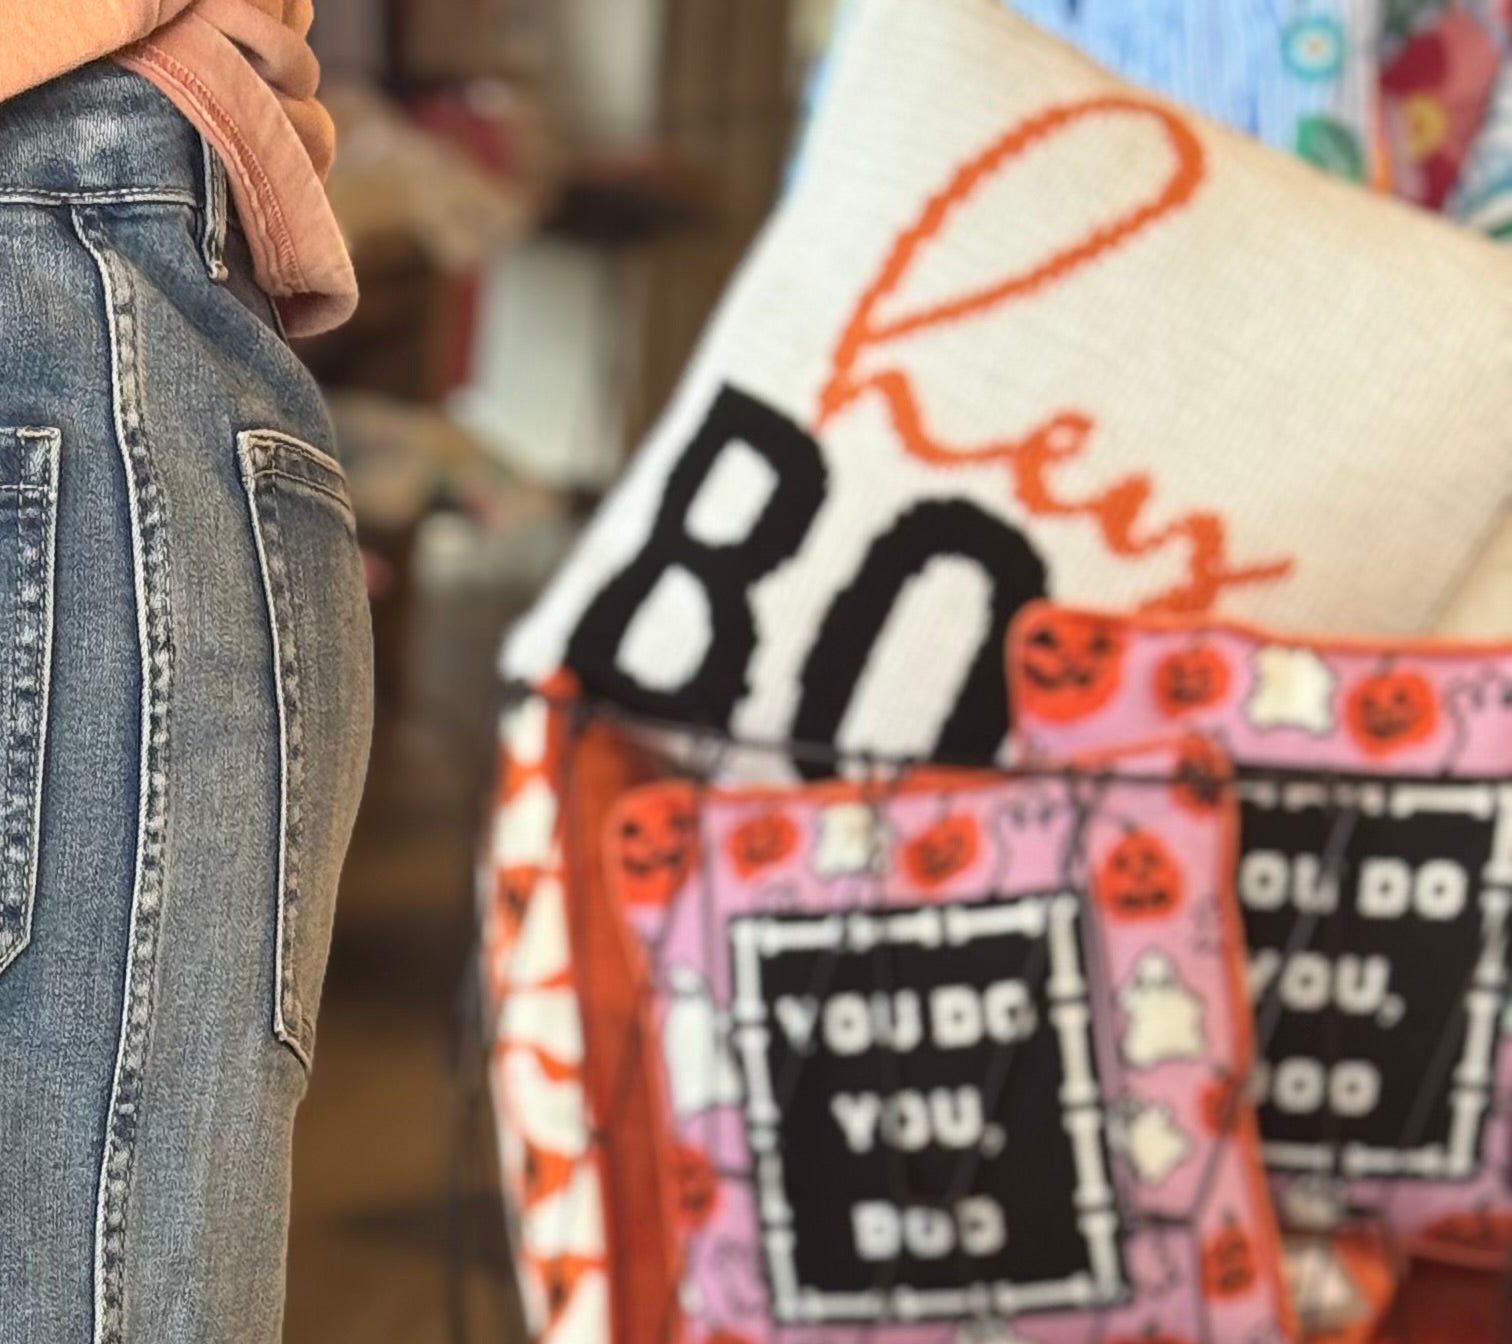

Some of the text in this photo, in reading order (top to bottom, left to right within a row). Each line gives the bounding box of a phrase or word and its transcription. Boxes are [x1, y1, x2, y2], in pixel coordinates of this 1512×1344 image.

[565, 379, 1044, 783] BO
[1239, 848, 1468, 921] OU DO
[774, 985, 922, 1057] YOU
[1252, 1055, 1382, 1118] OO
